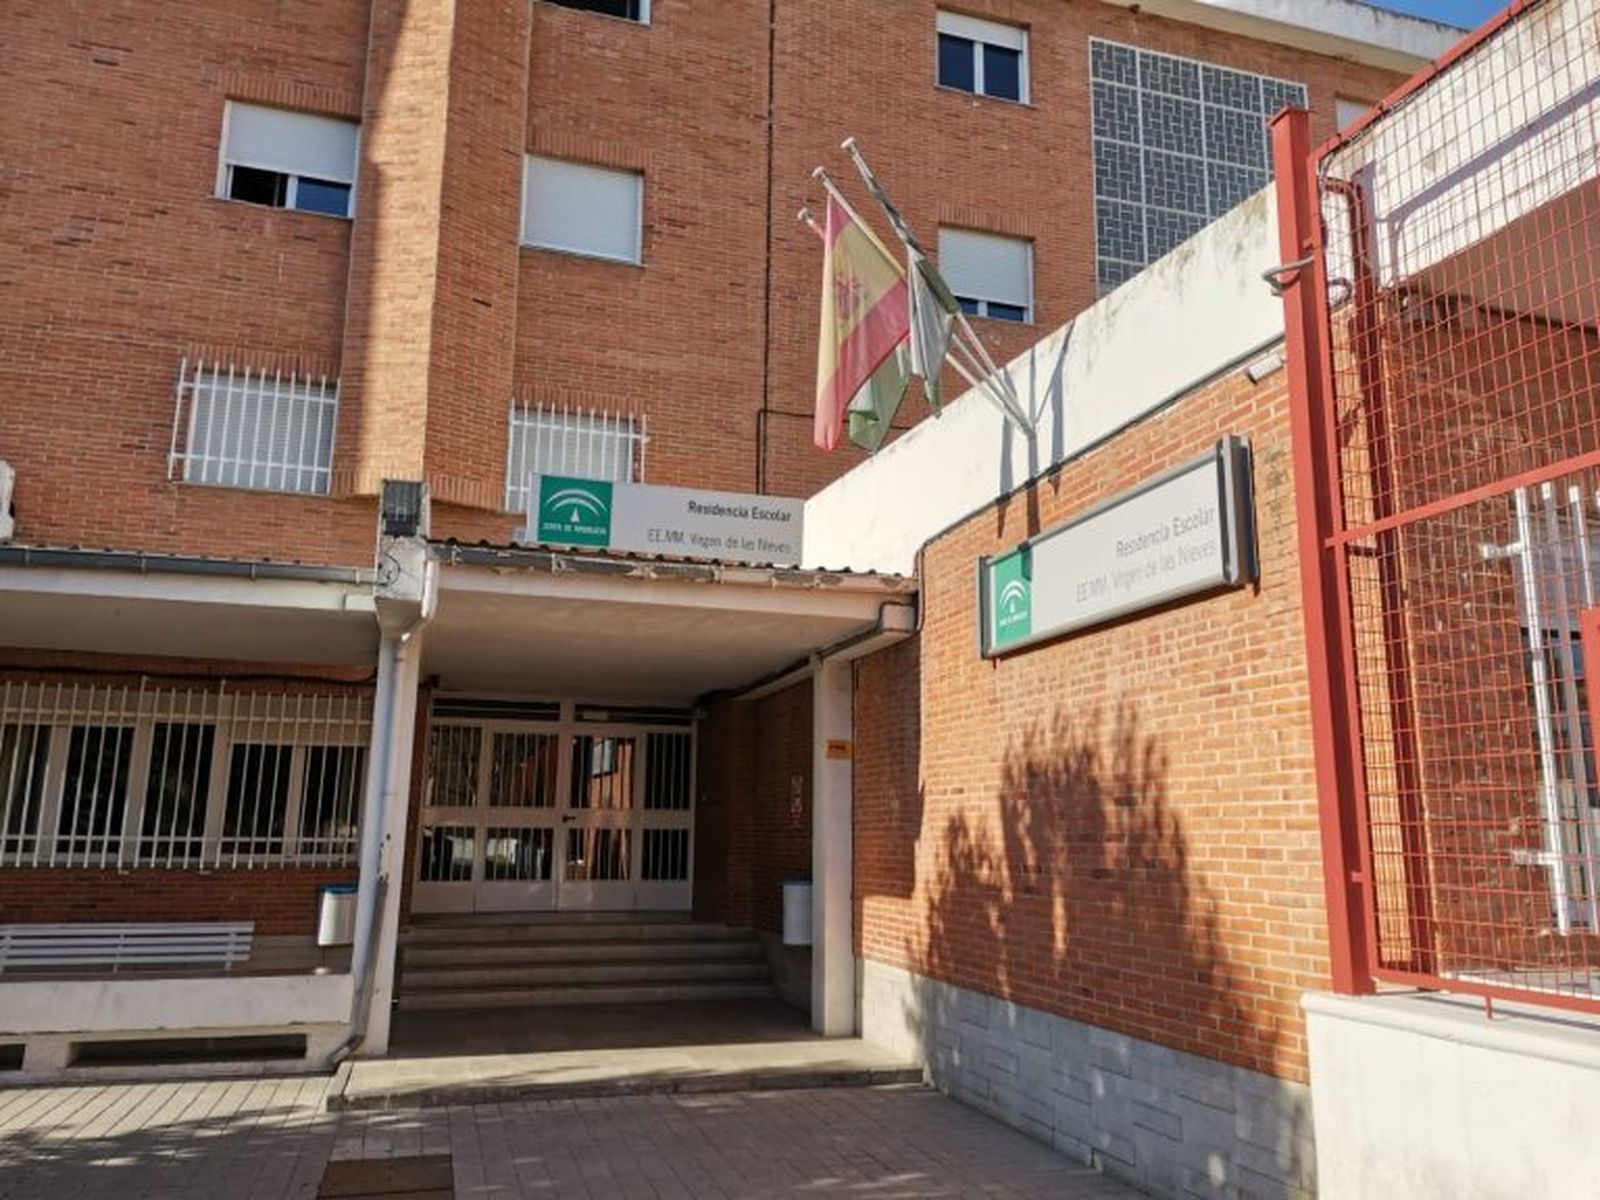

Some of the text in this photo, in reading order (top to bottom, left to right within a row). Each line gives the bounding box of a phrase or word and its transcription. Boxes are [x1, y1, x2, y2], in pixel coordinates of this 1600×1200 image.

[687, 500, 792, 522] Residencia Escolar
[725, 535, 738, 549] de
[741, 537, 755, 551] las
[1116, 506, 1215, 558] Residencia Escolar
